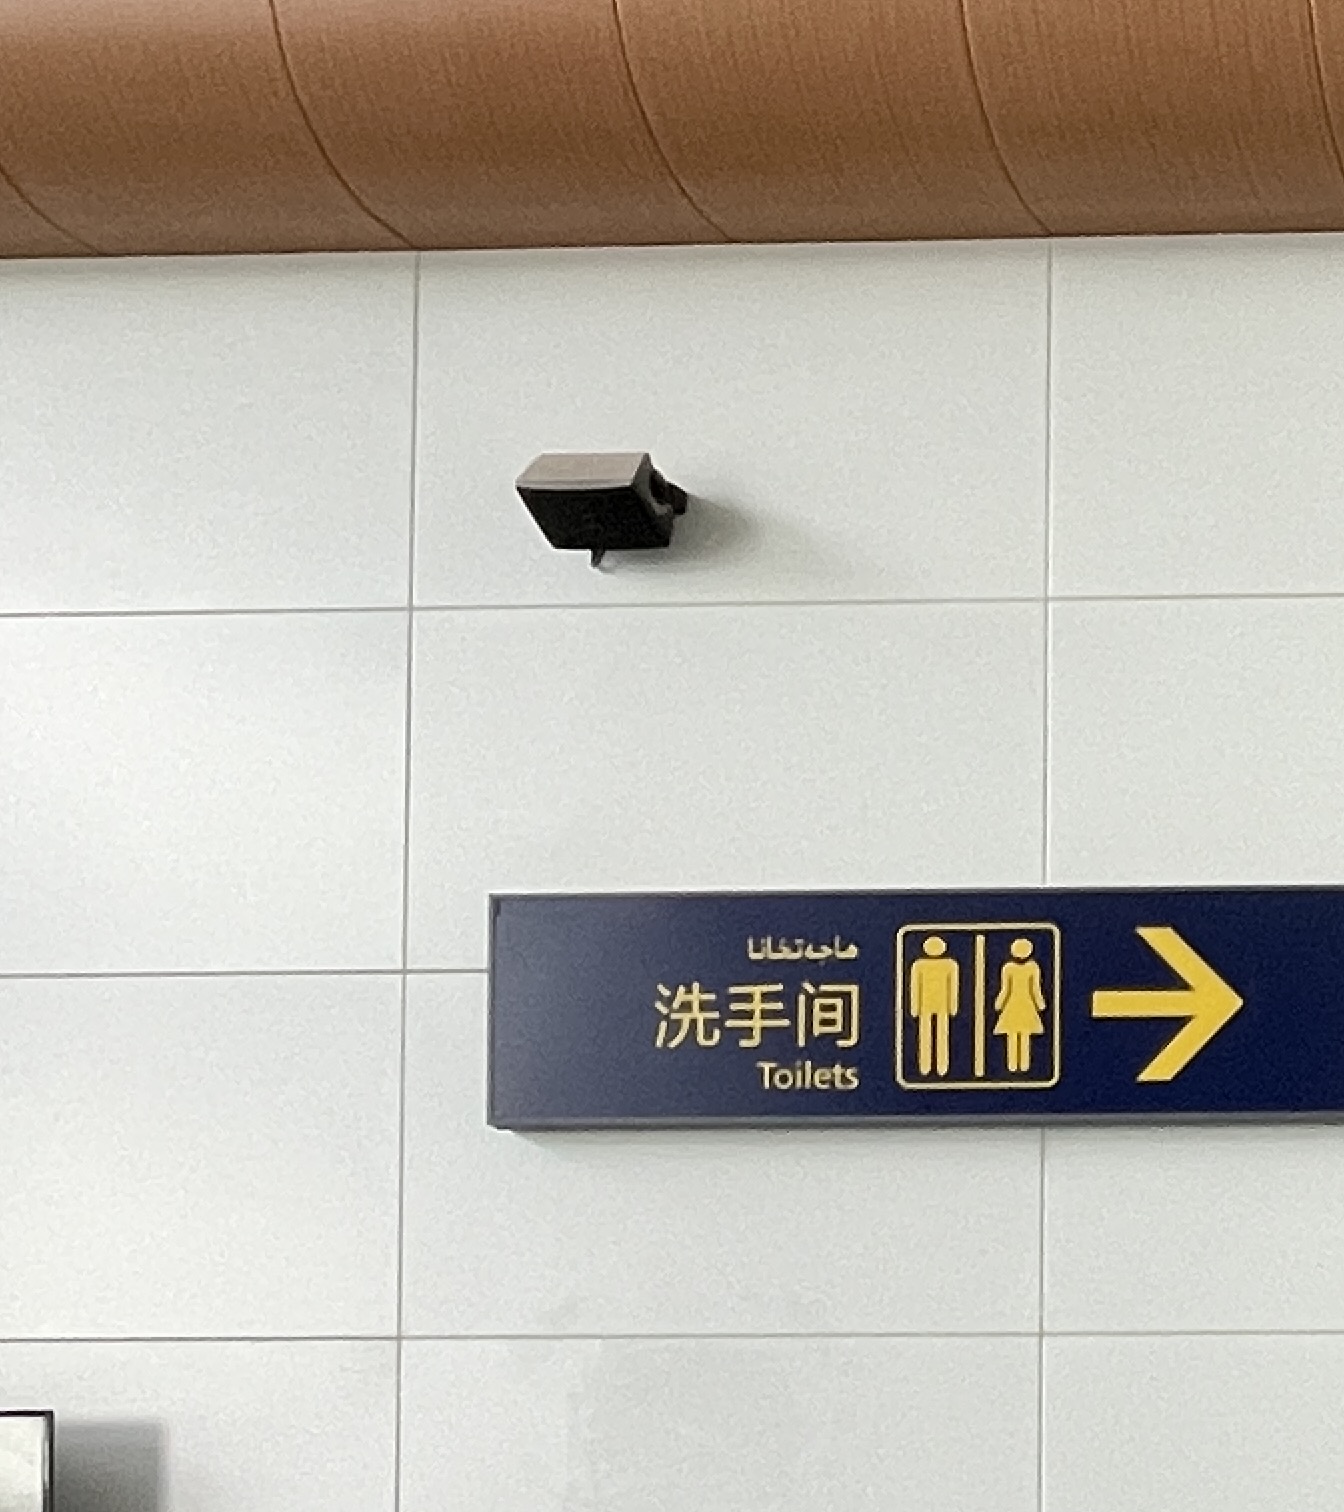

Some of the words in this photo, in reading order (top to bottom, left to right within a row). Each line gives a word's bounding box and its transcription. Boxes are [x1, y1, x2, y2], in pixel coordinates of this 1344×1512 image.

[653, 979, 861, 1050] 洗手间
[755, 1059, 861, 1091] Toilets
